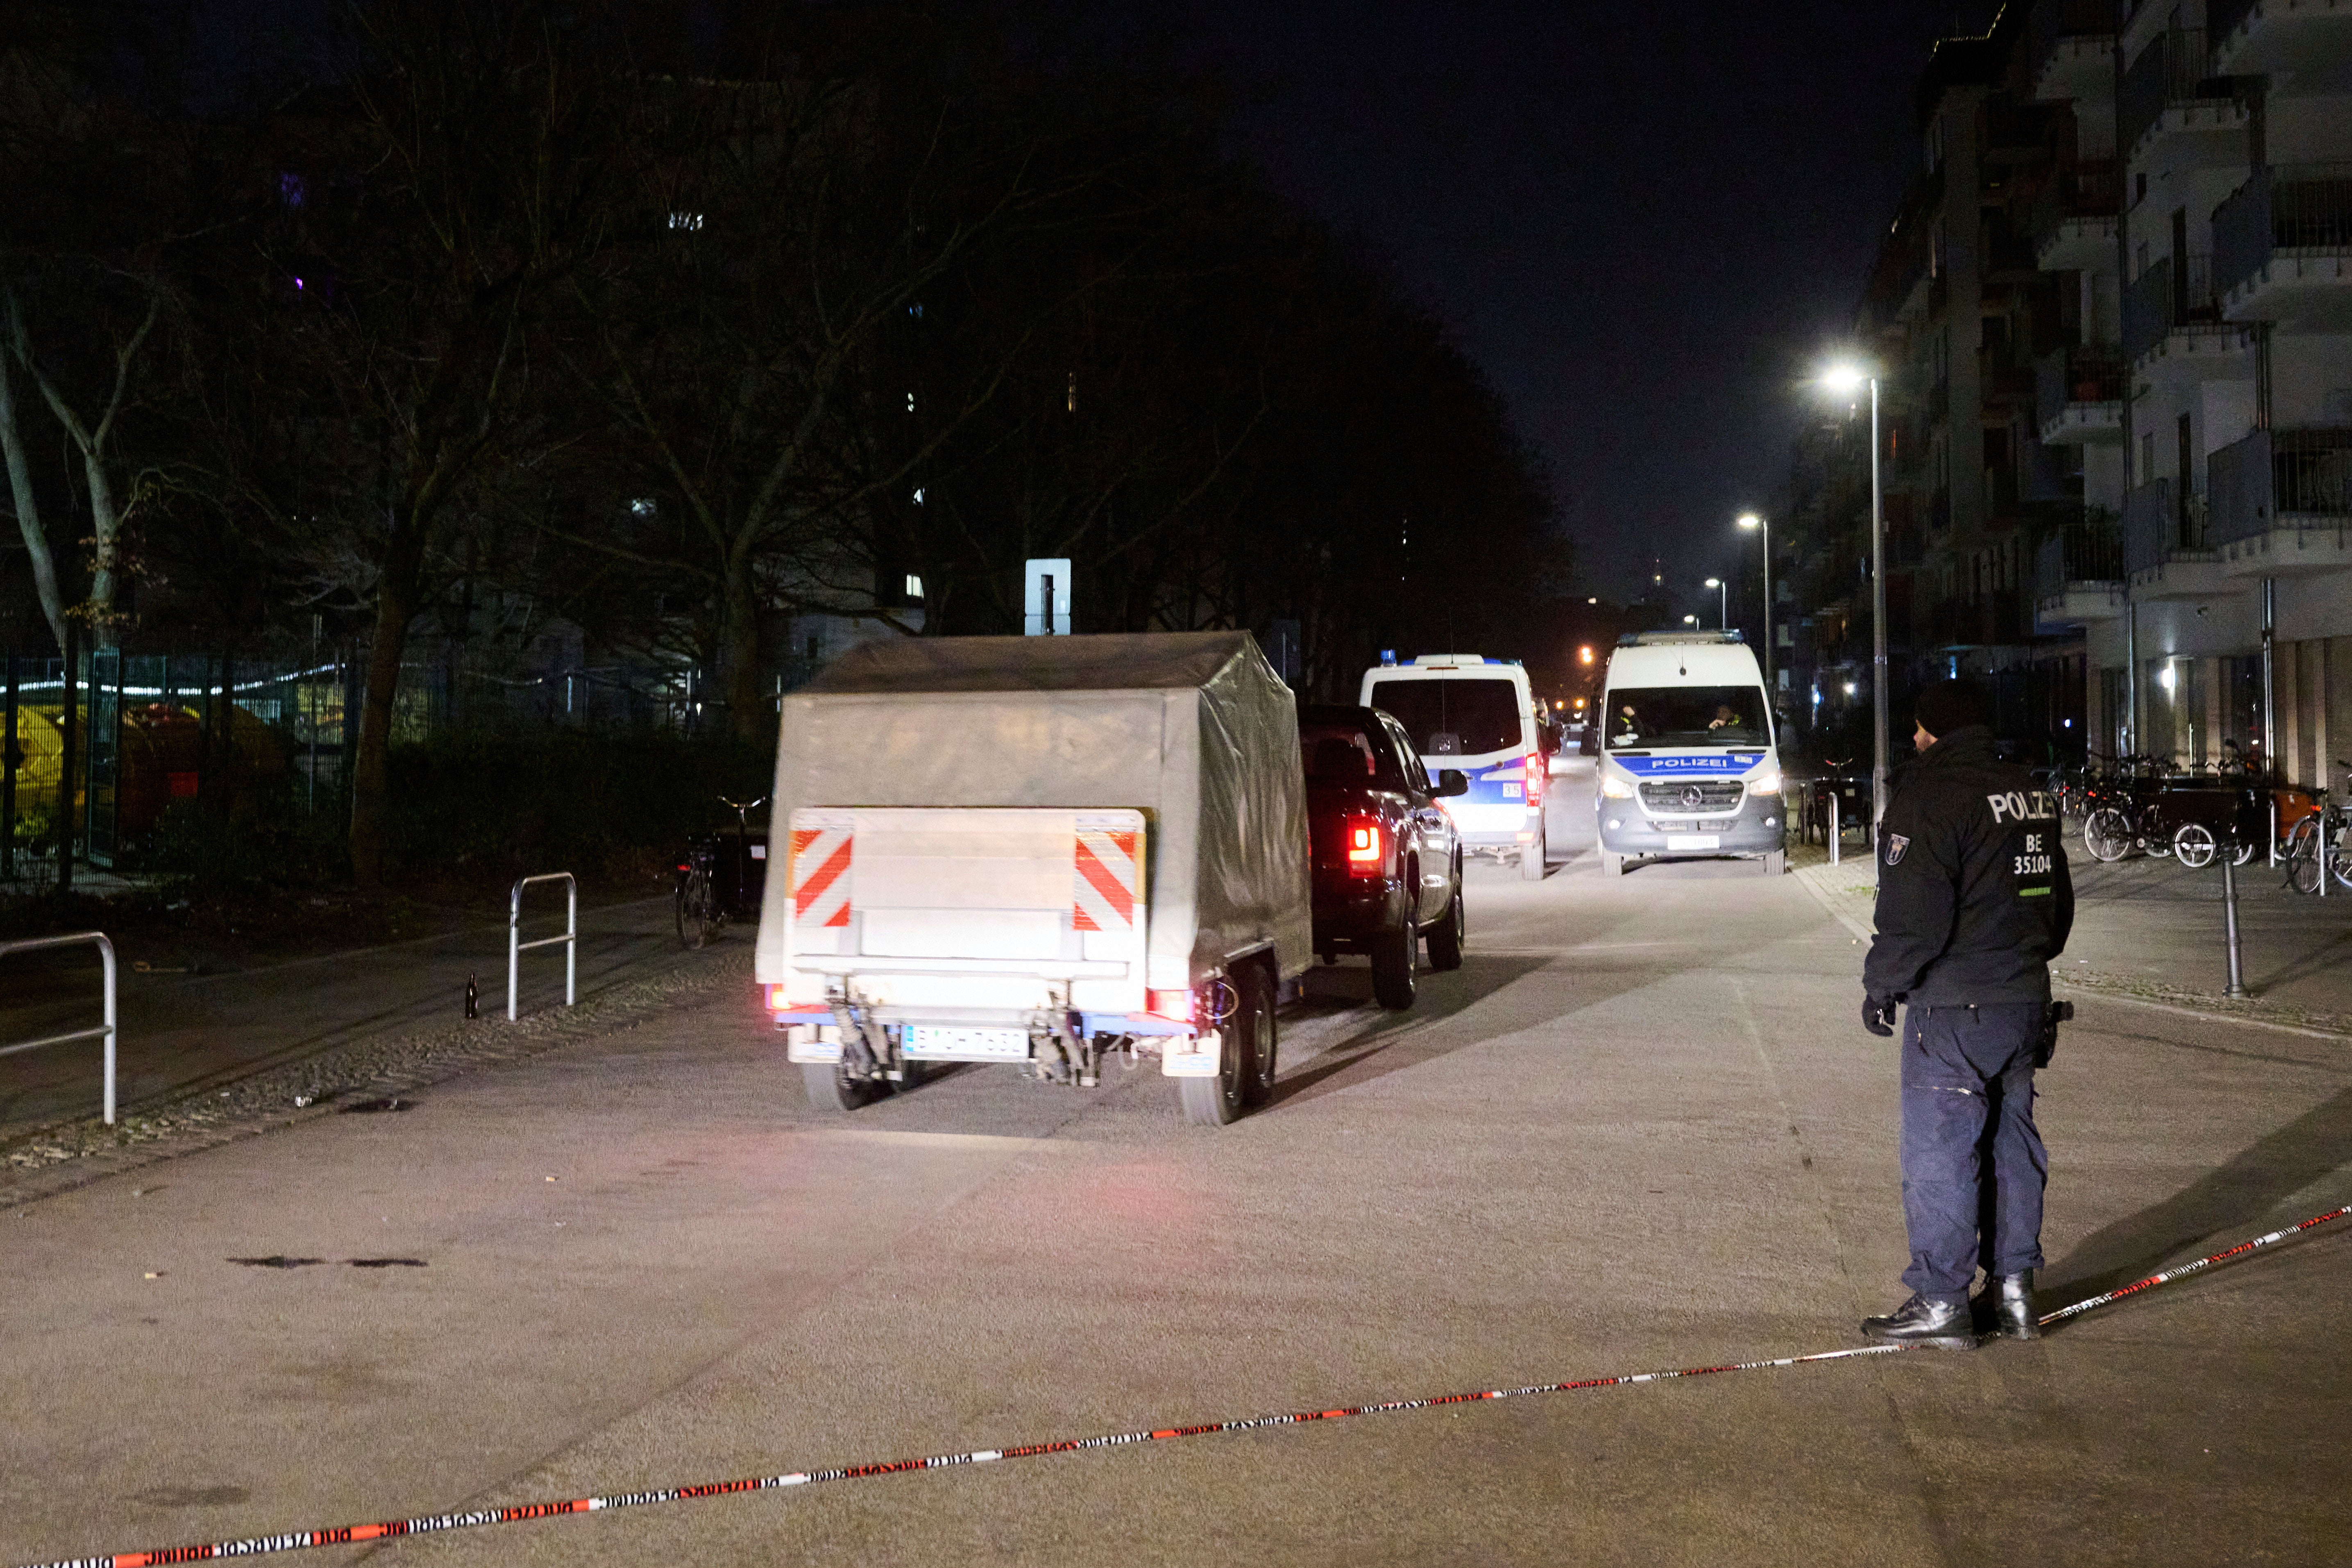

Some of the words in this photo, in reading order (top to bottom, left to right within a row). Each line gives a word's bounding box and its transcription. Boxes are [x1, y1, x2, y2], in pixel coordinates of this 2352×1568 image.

[1652, 758, 1726, 768] POLIZEI
[2026, 834, 2041, 852] BE
[2014, 855, 2051, 874] 35104
